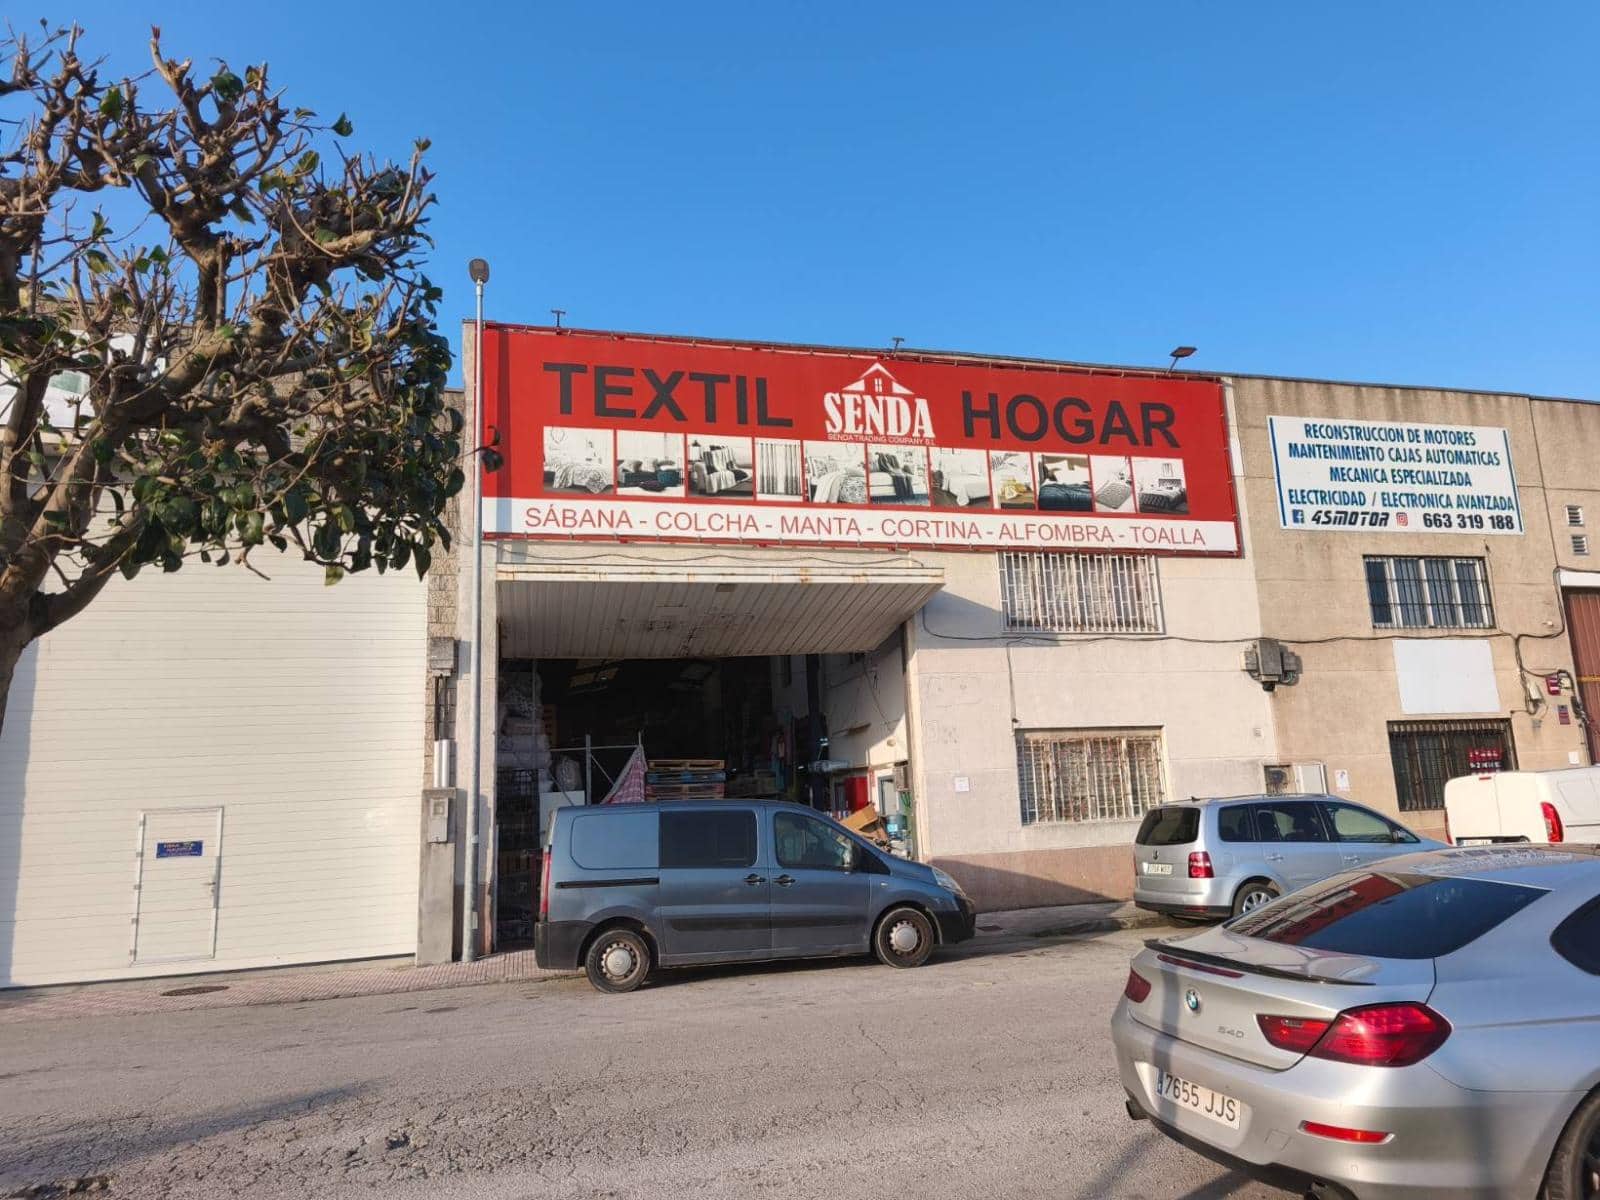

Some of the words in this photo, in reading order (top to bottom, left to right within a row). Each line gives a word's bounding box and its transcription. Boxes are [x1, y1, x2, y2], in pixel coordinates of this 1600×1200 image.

[543, 362, 793, 427] TEXTIL
[823, 391, 936, 439] SENDA
[962, 390, 1180, 447] HOGAR
[827, 433, 854, 441] SENDA
[854, 434, 886, 443] TRADING
[888, 436, 924, 445] COMPANY
[1304, 423, 1405, 444] RECONSTRUCCION
[1408, 429, 1422, 444] DE
[1424, 429, 1477, 447] MOTORES
[1288, 442, 1386, 463] MANTENIMIENTO
[1388, 447, 1423, 464] CAJAS
[1425, 449, 1501, 467] AUTOMATICAS
[1329, 466, 1389, 484] MECANICA
[1391, 469, 1473, 488] ESPECIALIZADA
[1288, 488, 1367, 507] ELECTRICIDAD
[1381, 492, 1452, 509] ELECTRONICA
[1456, 494, 1515, 512] AVANZADA
[524, 504, 633, 529] SÁBANA
[655, 511, 759, 534] COLCHA
[780, 516, 861, 537] MANTA
[881, 518, 981, 542] CORTINA
[998, 522, 1115, 543] ALFOMBRA
[1130, 526, 1207, 546] TOALLA
[1423, 512, 1452, 529] 663
[1457, 514, 1484, 530] 319
[1491, 515, 1515, 531] 188
[1165, 1074, 1200, 1108] 7655
[1205, 1092, 1237, 1123] JJS
